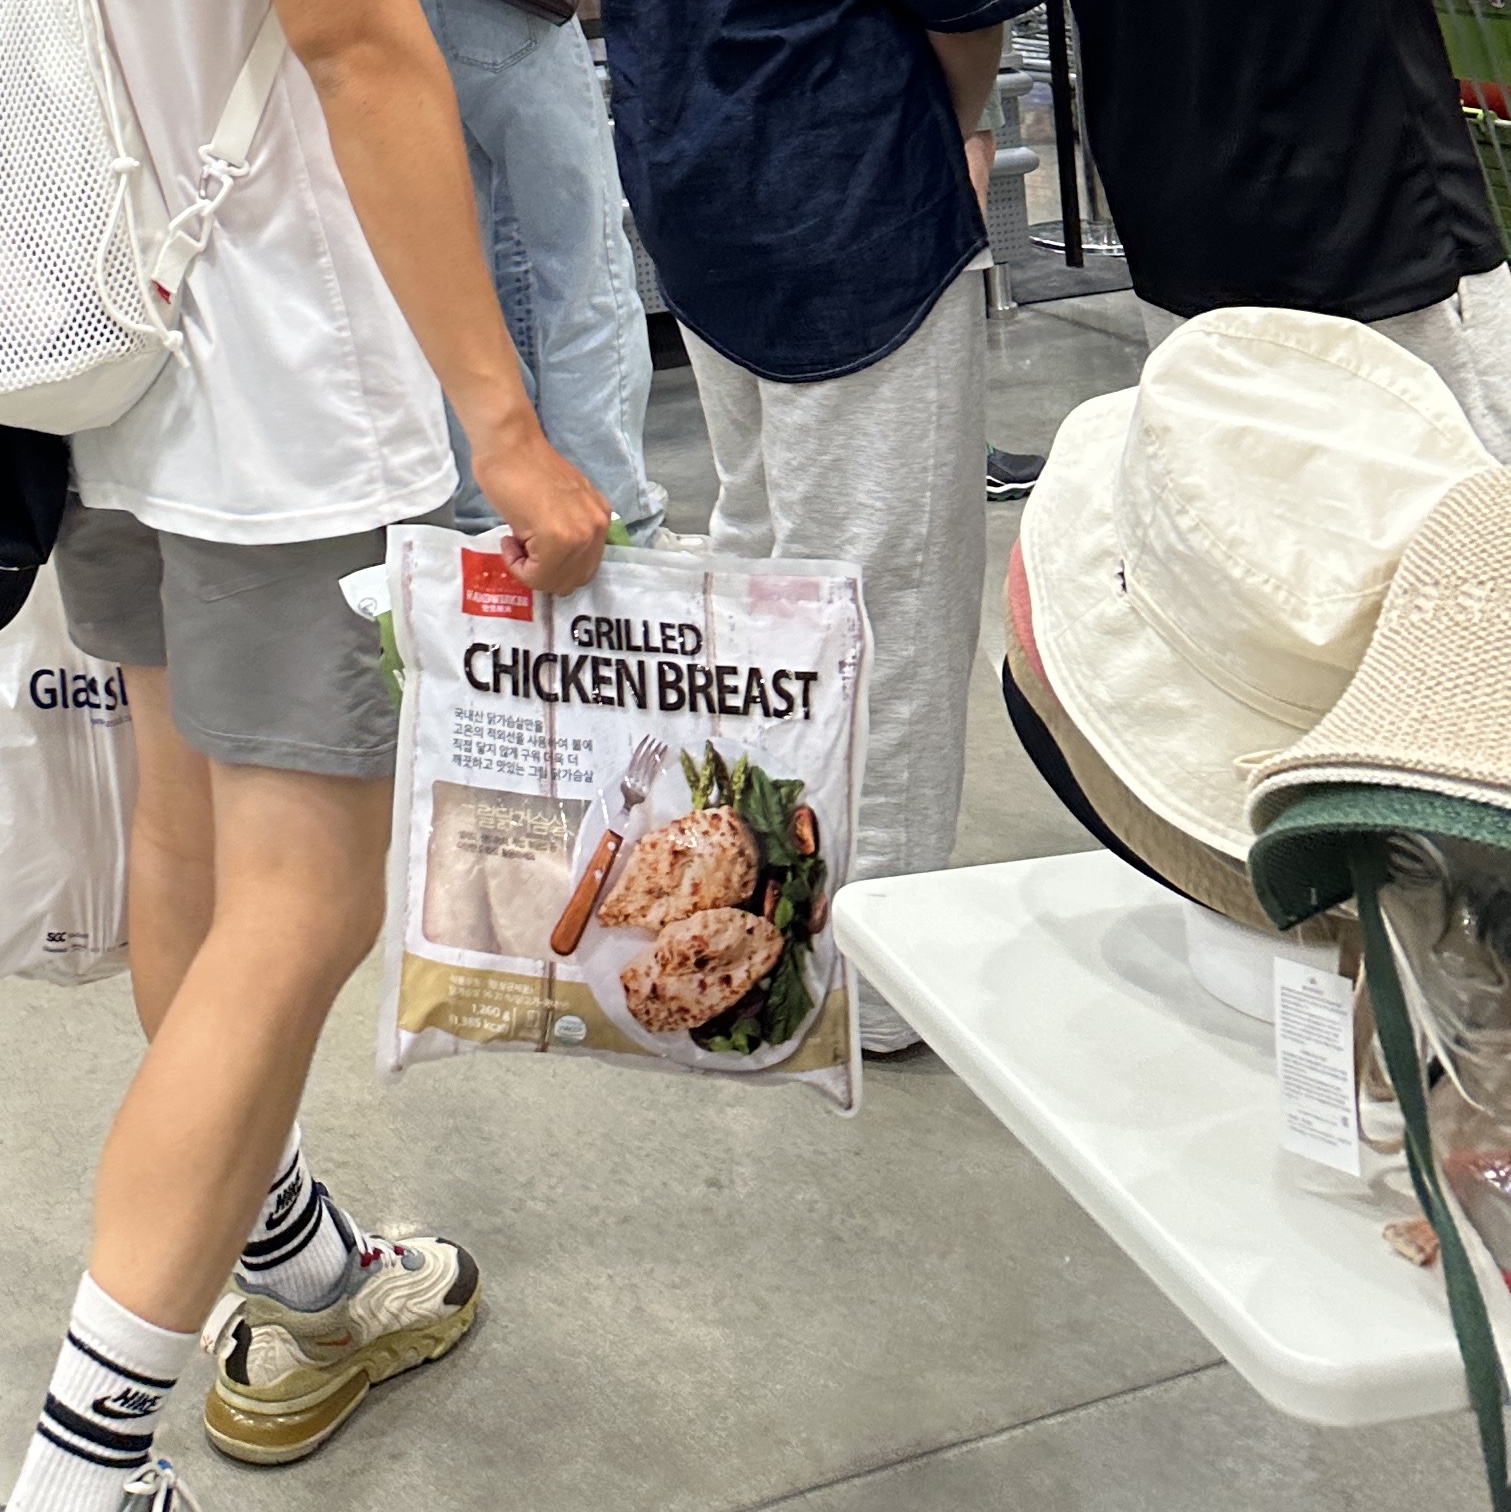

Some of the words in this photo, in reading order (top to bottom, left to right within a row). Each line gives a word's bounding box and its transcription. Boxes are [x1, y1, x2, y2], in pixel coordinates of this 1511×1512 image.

[571, 615, 703, 656] GRILLED
[464, 643, 647, 710] CHICKEN
[659, 661, 818, 720] BREAST
[455, 707, 484, 723] 국내산
[453, 723, 484, 737] 고온의
[488, 728, 524, 745] 적외선을
[453, 738, 473, 753] 직접
[568, 754, 579, 766] 더
[452, 754, 493, 770] 깨끗하고
[496, 760, 525, 776] 맛있는
[112, 1387, 163, 1412] NIKE
